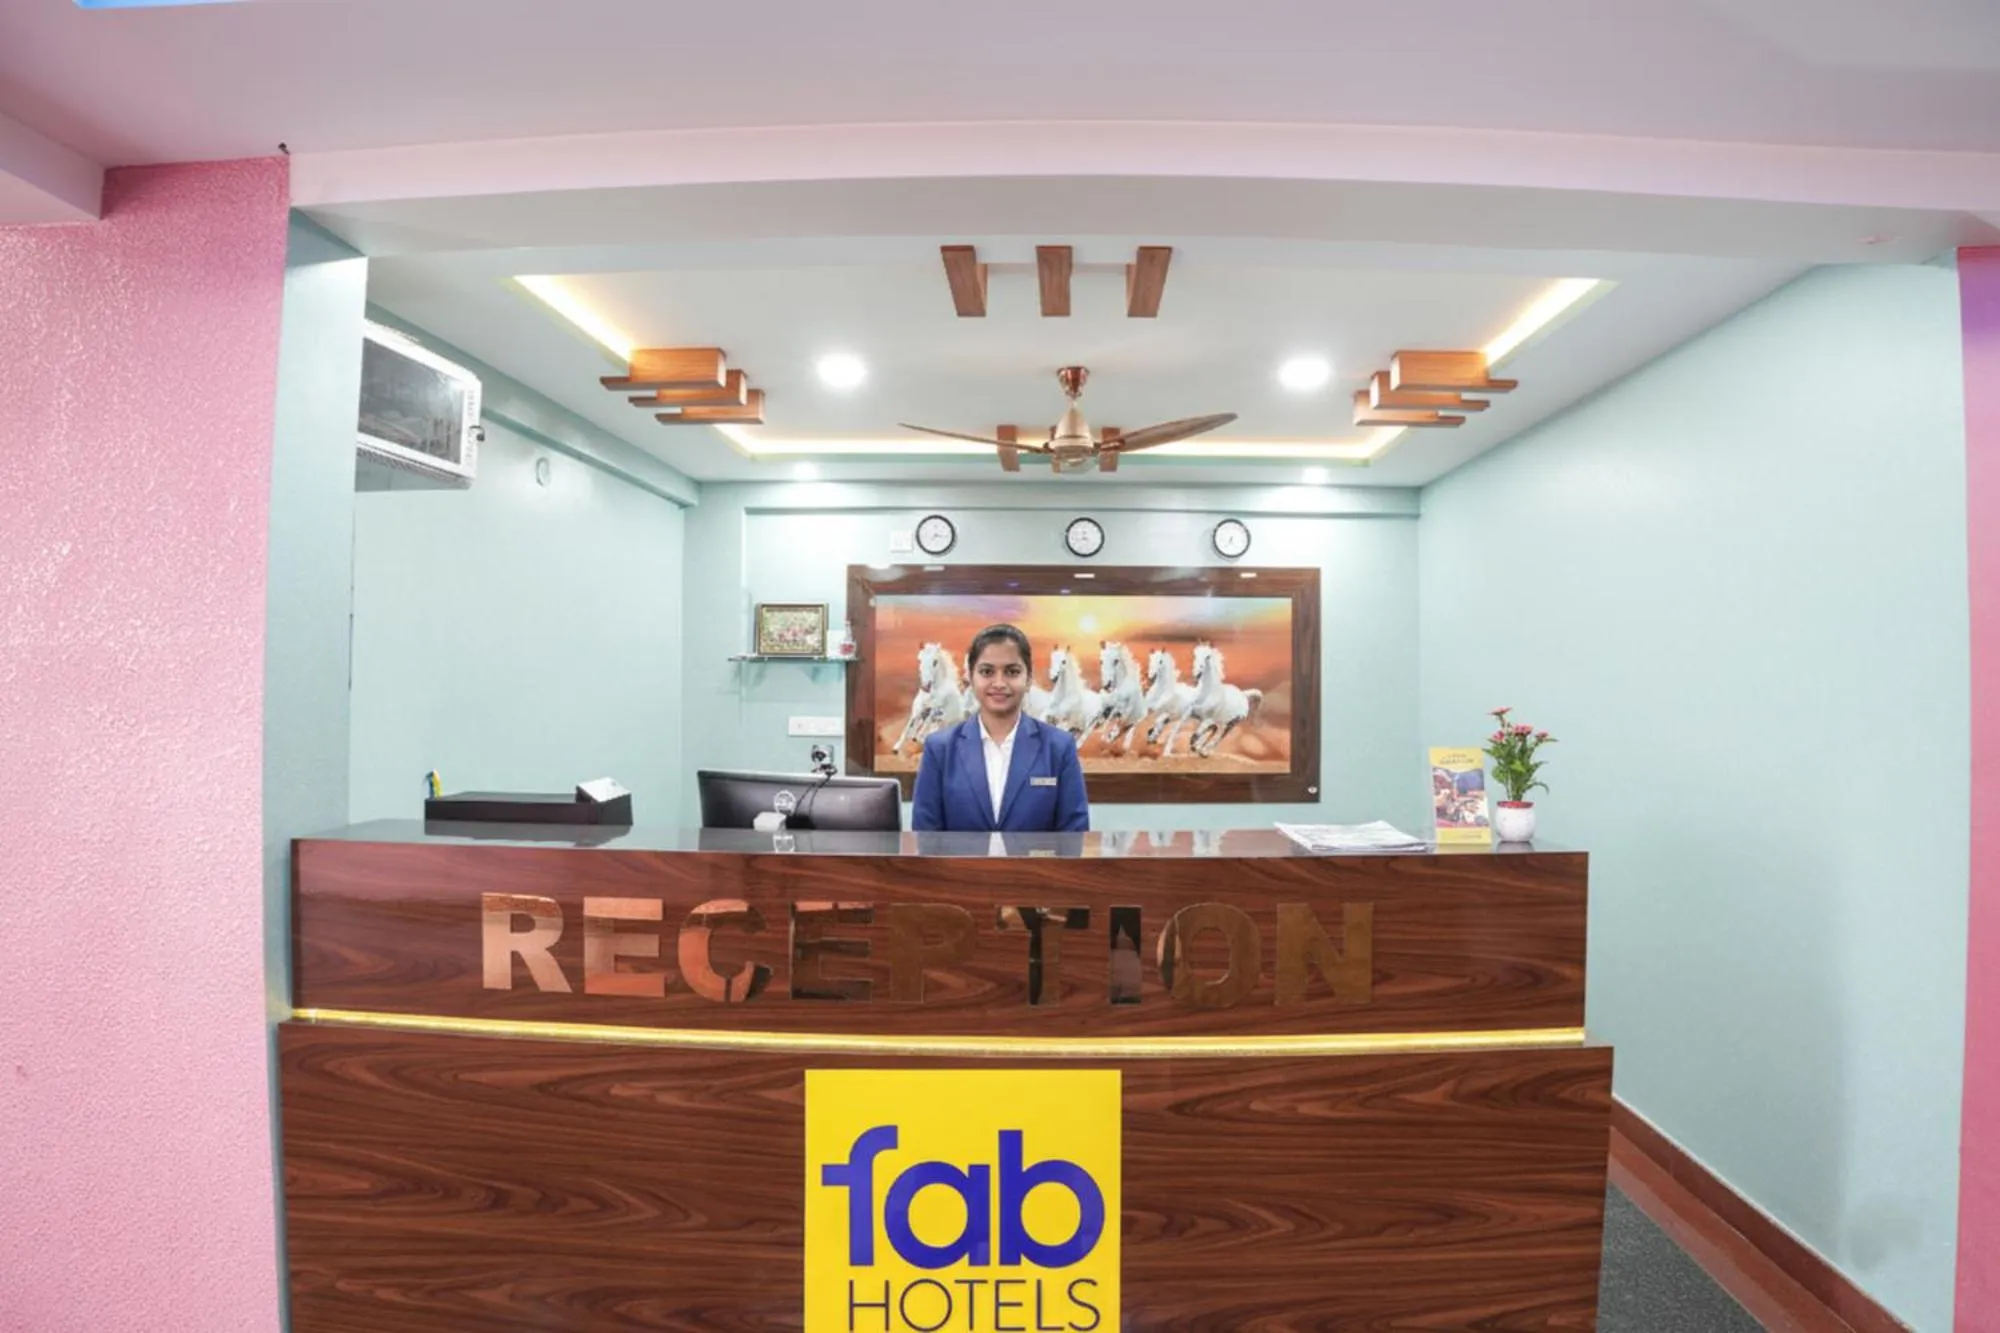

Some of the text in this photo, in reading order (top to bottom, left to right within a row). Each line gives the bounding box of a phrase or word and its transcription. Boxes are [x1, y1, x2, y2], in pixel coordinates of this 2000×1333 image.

[481, 892, 1374, 1007] RECEPTION
[821, 1125, 1105, 1269] fab
[849, 1278, 1100, 1332] HOTELS
